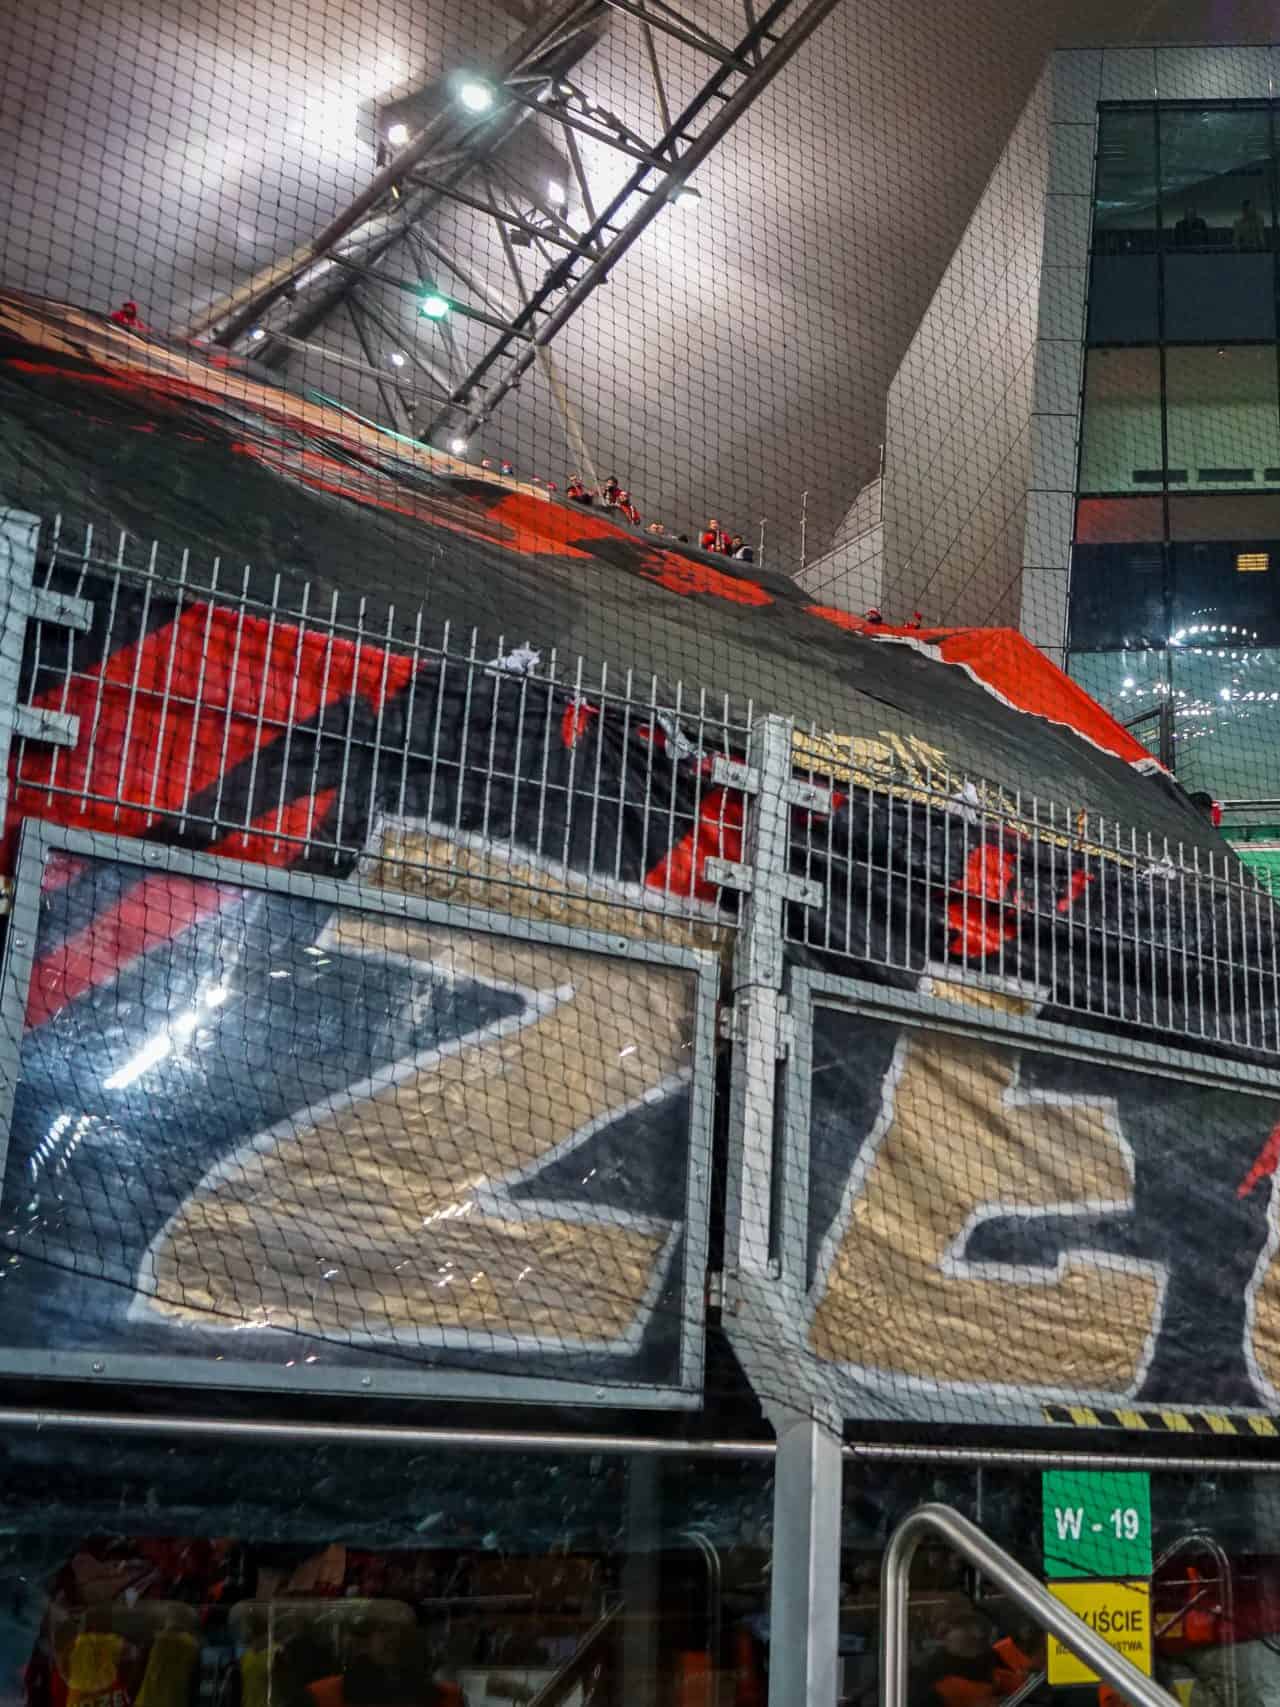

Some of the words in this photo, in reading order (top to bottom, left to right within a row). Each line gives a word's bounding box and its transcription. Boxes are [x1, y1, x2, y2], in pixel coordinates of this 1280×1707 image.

[1054, 1507, 1084, 1540] W
[1110, 1508, 1140, 1540] 19
[1074, 1604, 1144, 1634] JŚCIE
